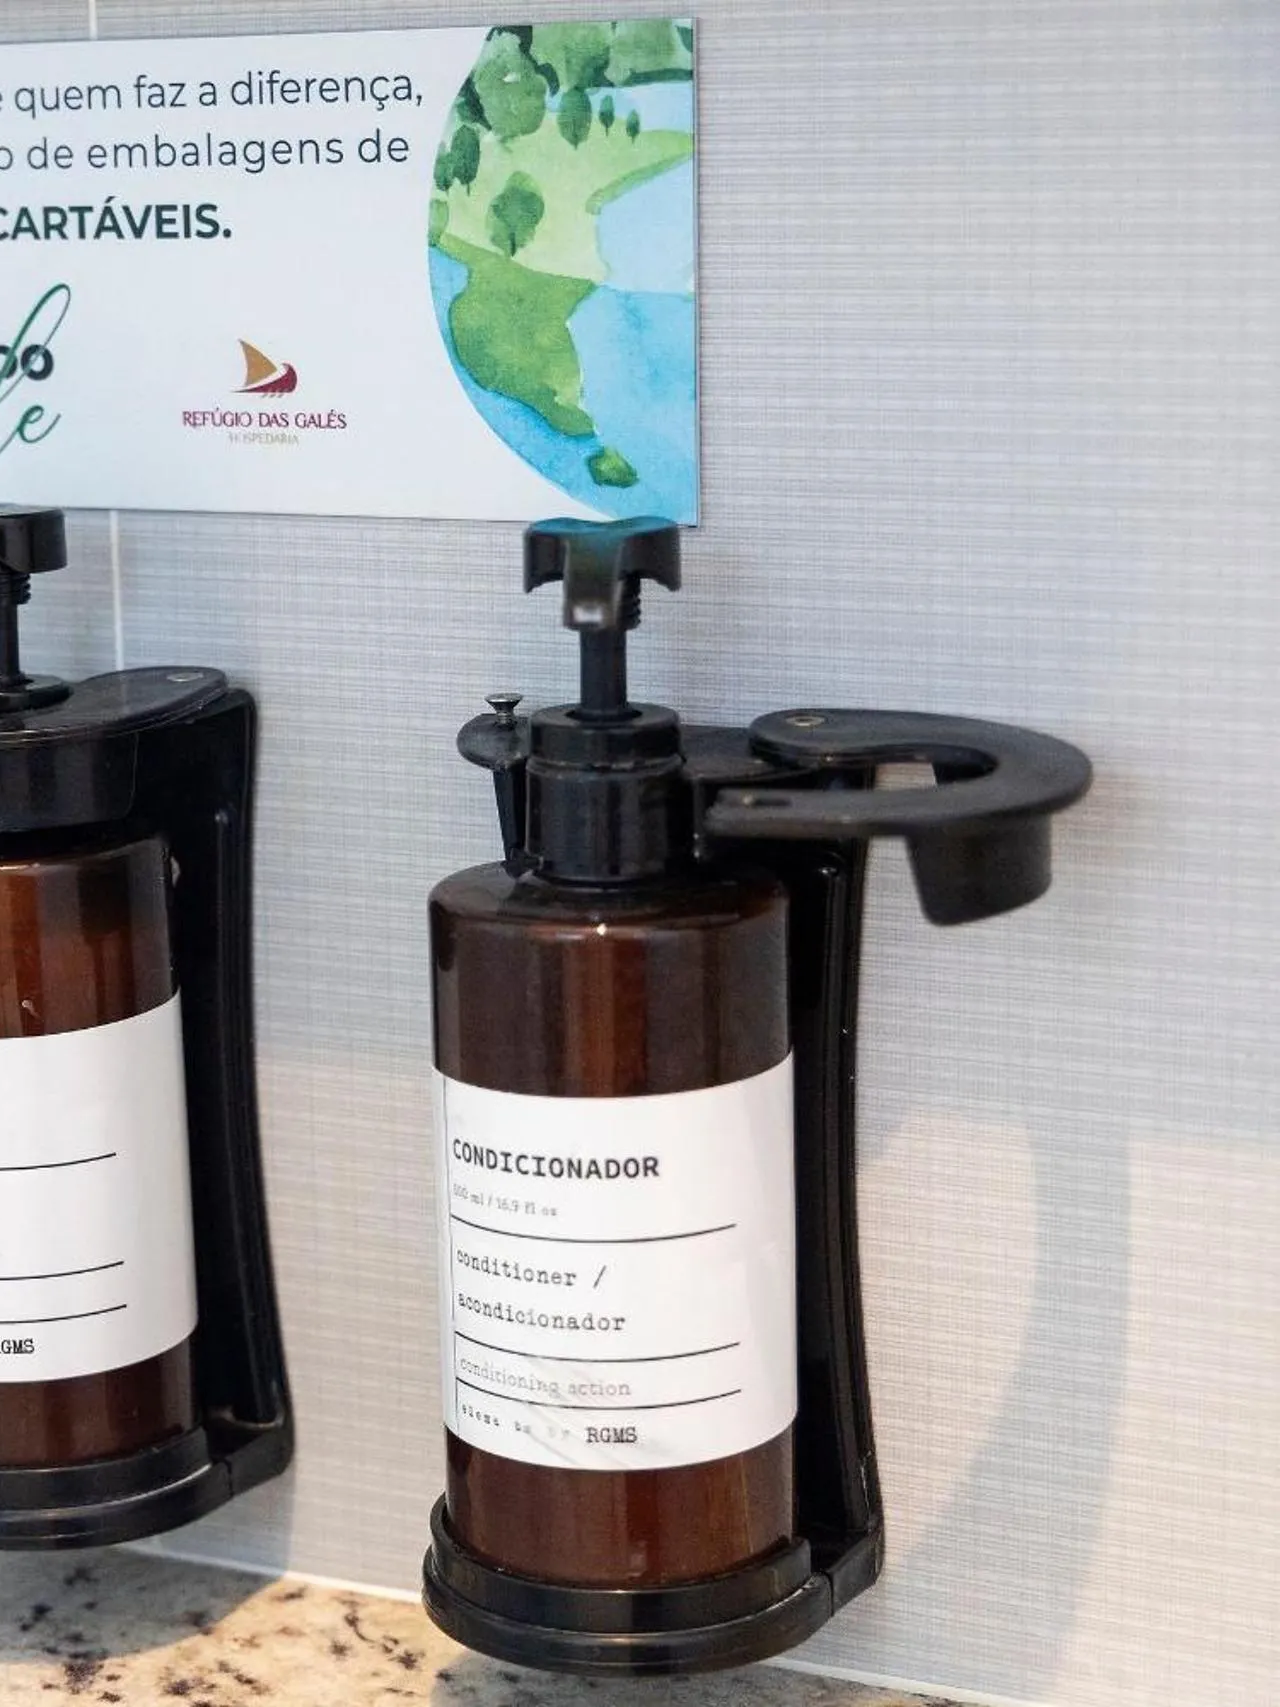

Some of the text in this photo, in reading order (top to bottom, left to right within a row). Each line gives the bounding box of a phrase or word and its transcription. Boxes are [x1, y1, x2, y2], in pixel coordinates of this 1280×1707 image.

[14, 84, 122, 119] quem
[133, 74, 187, 110] faz
[198, 81, 219, 108] a
[230, 69, 423, 112] diferença,
[26, 136, 75, 170] de
[87, 132, 344, 174] embalagens
[358, 128, 410, 163] de
[182, 407, 348, 430] REFÚGIO DAS GALÉS
[452, 1138, 660, 1181] CONDICIONADOR
[455, 1248, 577, 1287] conditioner
[457, 1292, 626, 1331] acondicionador
[459, 1355, 632, 1399] conditioning action
[584, 1425, 639, 1445] RGMS
